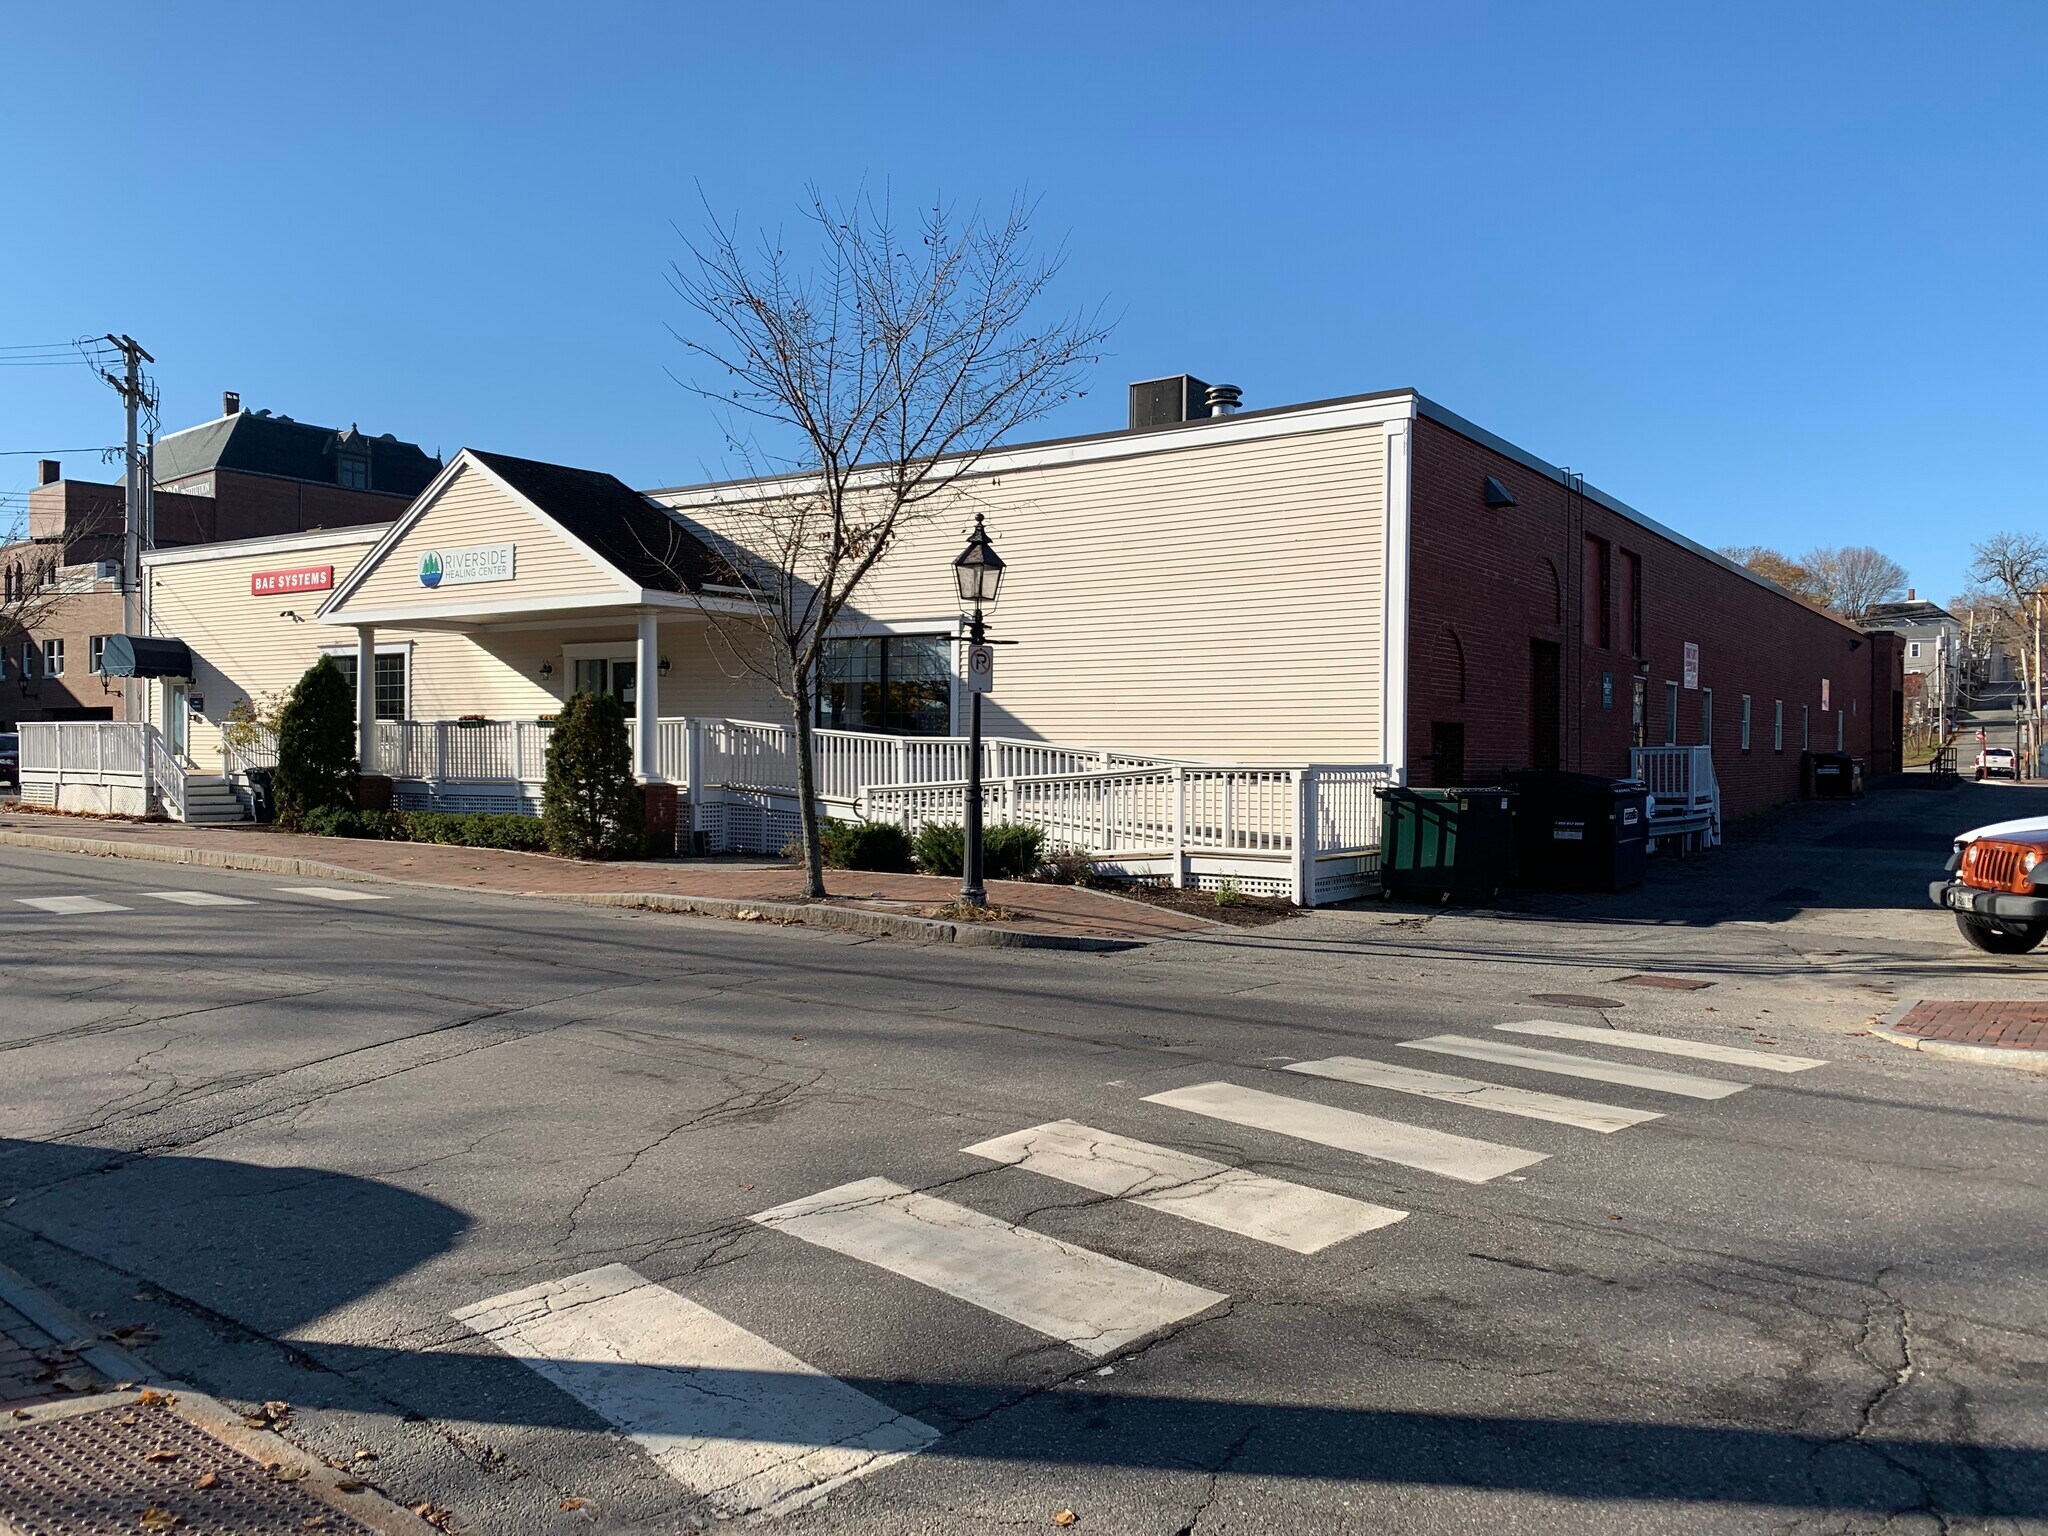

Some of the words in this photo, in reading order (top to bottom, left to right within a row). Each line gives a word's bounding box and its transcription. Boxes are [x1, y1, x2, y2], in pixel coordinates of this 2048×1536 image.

[446, 550, 507, 568] RIVERSIDE
[255, 577, 275, 590] BAE
[278, 571, 327, 587] SYSTEMS
[446, 568, 476, 578] HEALING
[479, 566, 507, 576] CENTER
